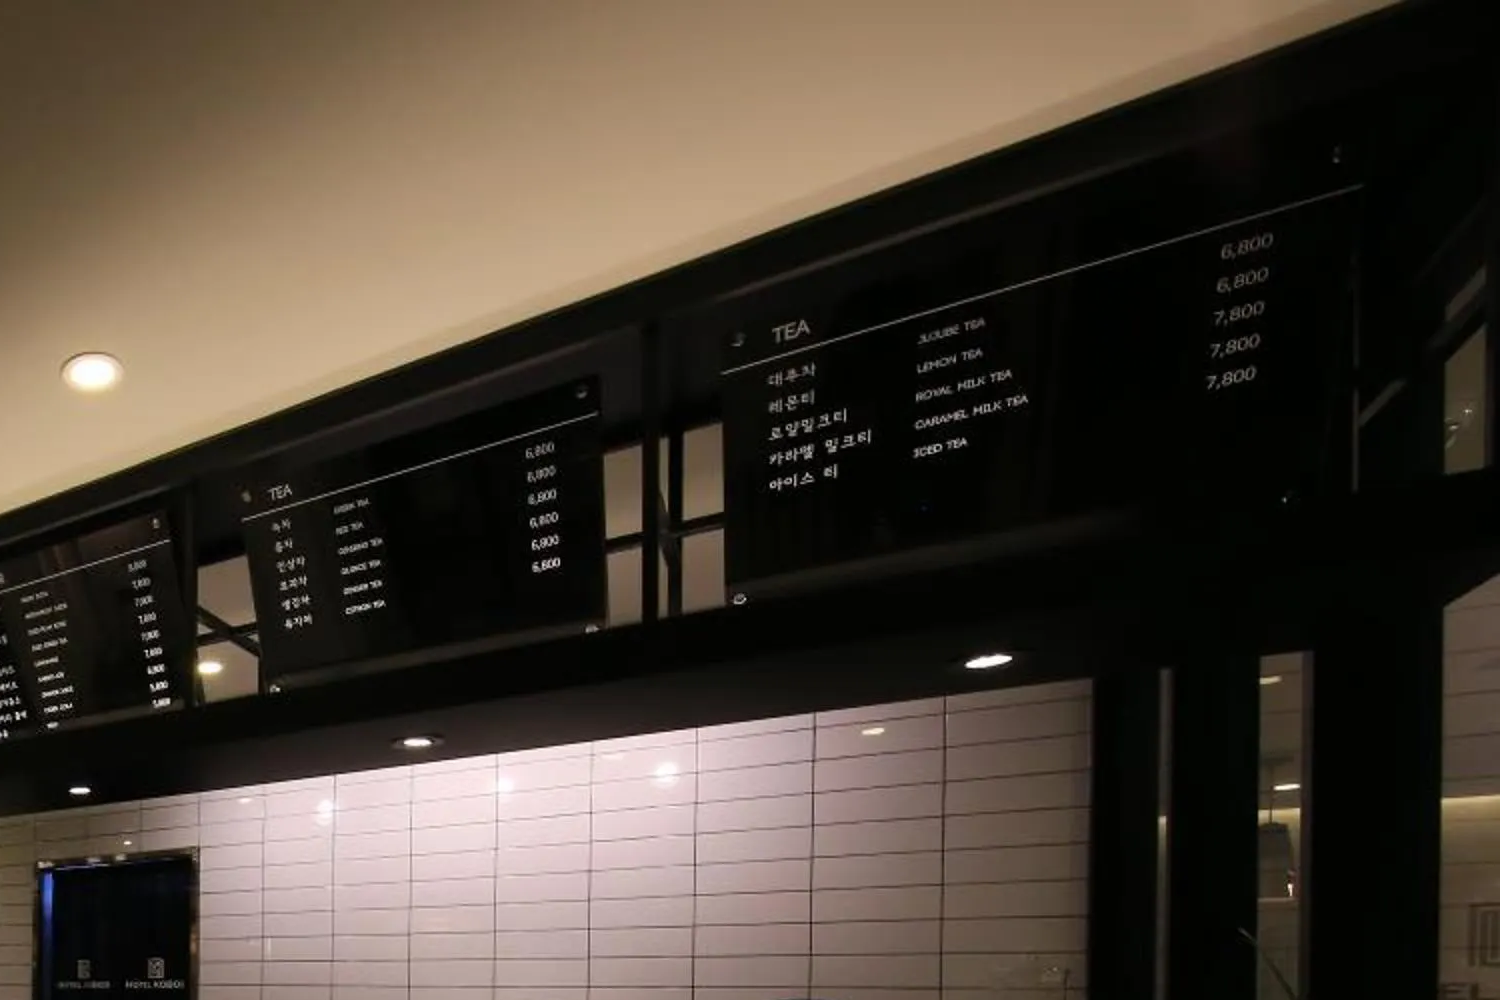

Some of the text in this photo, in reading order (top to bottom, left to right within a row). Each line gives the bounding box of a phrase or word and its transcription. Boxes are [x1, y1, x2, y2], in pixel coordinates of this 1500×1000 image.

[1220, 232, 1274, 260] 6,800
[1216, 266, 1269, 294] 6,800
[964, 317, 986, 332] TEA
[1213, 300, 1266, 327] 7,800
[772, 319, 811, 343] TEA
[1209, 333, 1261, 359] 7,800
[916, 348, 983, 375] LEMON TEA
[915, 369, 1013, 403] ROYAL MILK TEA
[1206, 365, 1258, 390] 7,800
[914, 394, 1029, 431] CARAMEL MILK TEA
[947, 437, 969, 450] TEA
[267, 483, 293, 501] TEA
